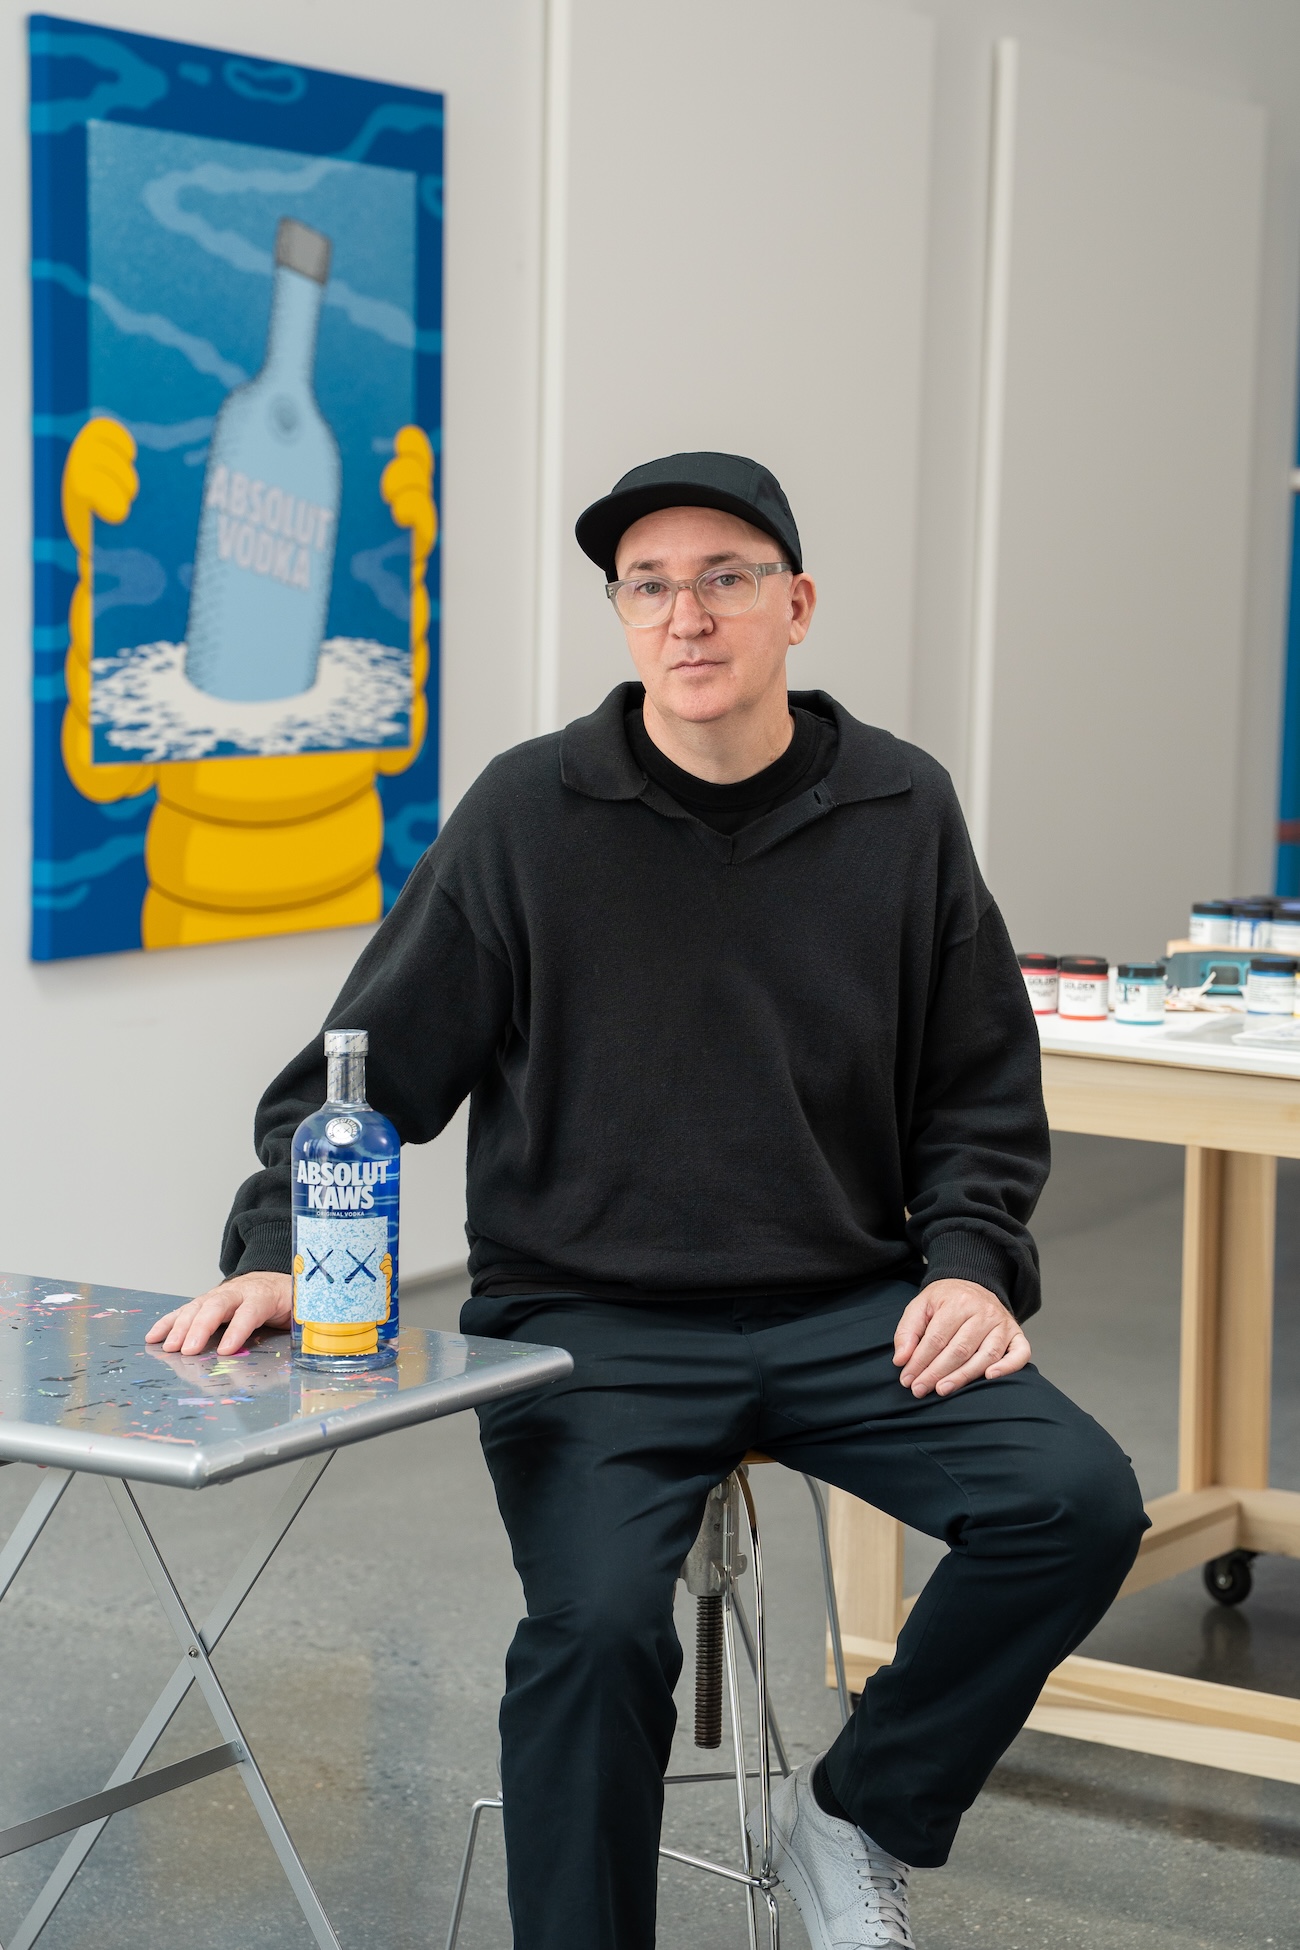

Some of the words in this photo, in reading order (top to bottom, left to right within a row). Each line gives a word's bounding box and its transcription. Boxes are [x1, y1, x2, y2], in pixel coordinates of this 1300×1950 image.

[206, 464, 334, 552] ABSOLUT
[217, 513, 310, 590] VODKA
[297, 1160, 389, 1187] ABSOLUT
[308, 1185, 375, 1210] KAWS
